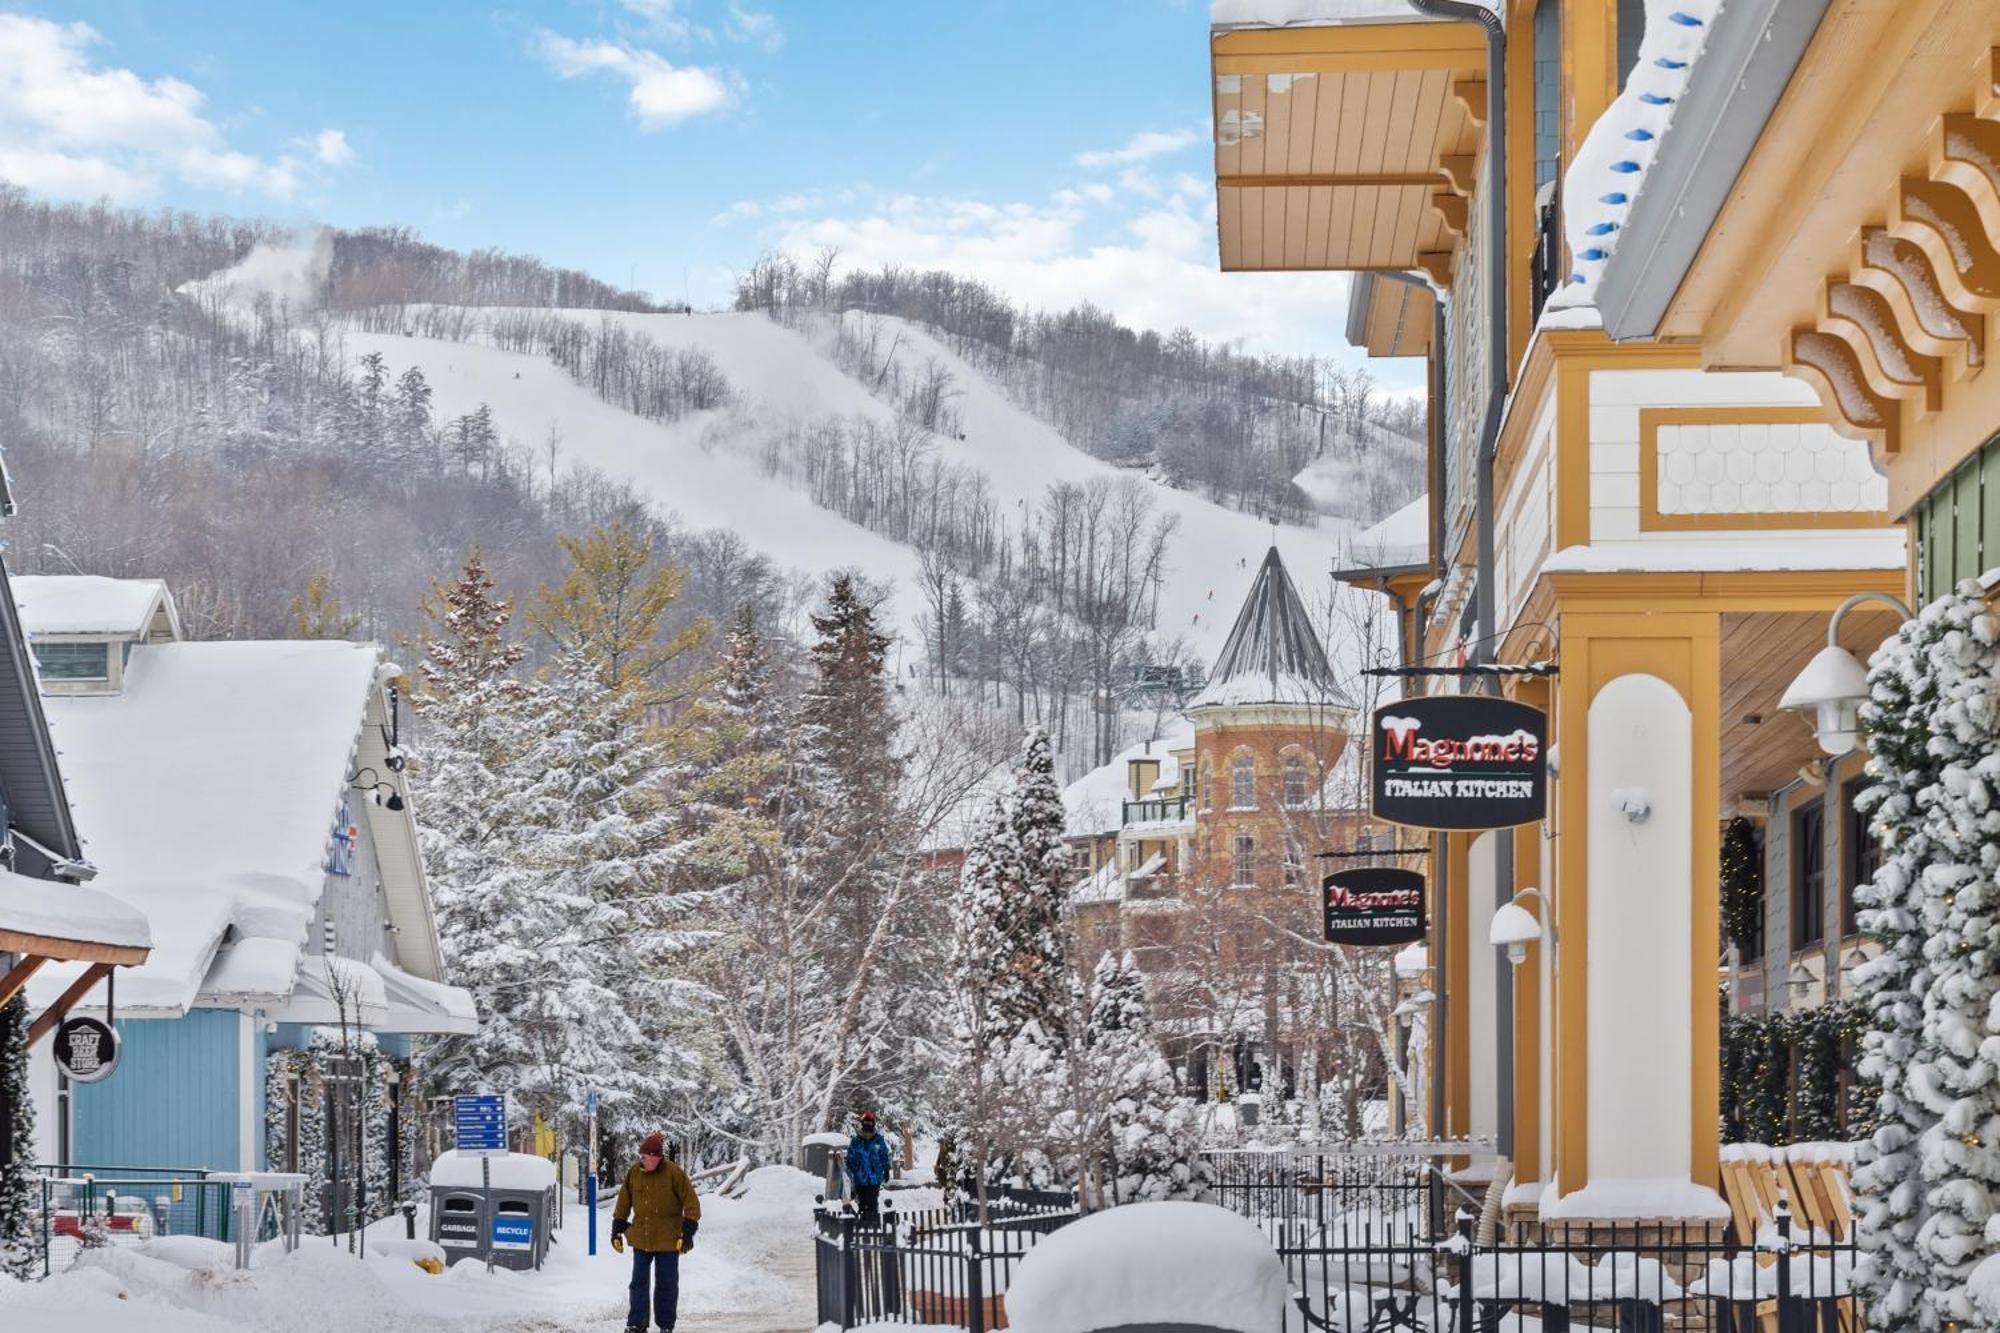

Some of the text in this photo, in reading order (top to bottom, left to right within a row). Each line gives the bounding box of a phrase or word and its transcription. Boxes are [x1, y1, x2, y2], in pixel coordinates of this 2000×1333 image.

[1383, 725, 1537, 768] Magnone's
[1385, 780, 1534, 799] ITALIAN KITCHEN
[1328, 886, 1420, 910] Magnone's
[1331, 917, 1418, 929] ITALIAN KITCHEN
[69, 1034, 102, 1046] CRAFT
[441, 1224, 477, 1233] GARBAGE
[496, 1226, 529, 1235] RECYCLE
